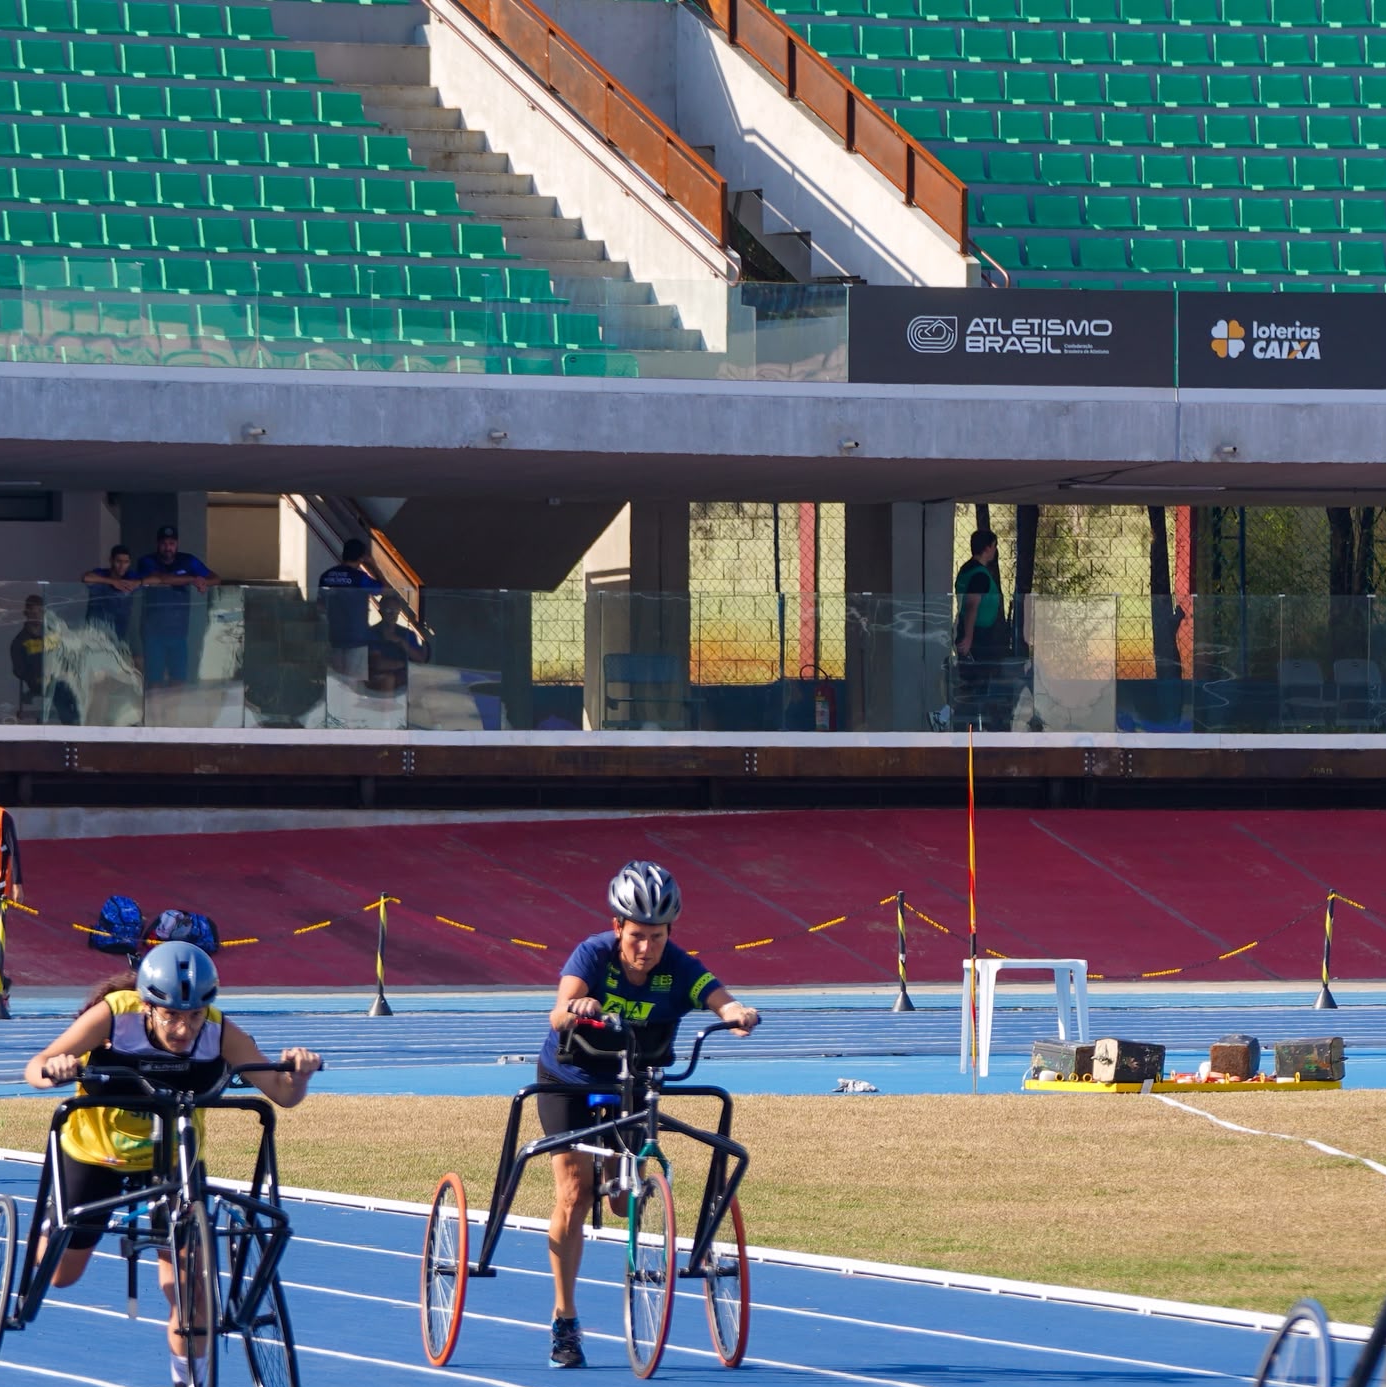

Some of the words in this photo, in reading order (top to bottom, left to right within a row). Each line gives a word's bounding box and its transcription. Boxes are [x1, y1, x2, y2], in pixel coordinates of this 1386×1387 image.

[966, 318, 1113, 336] ATLETISMO
[1252, 320, 1321, 340] loterias
[965, 336, 1062, 353] BRASIL
[1252, 340, 1321, 359] CAIXA
